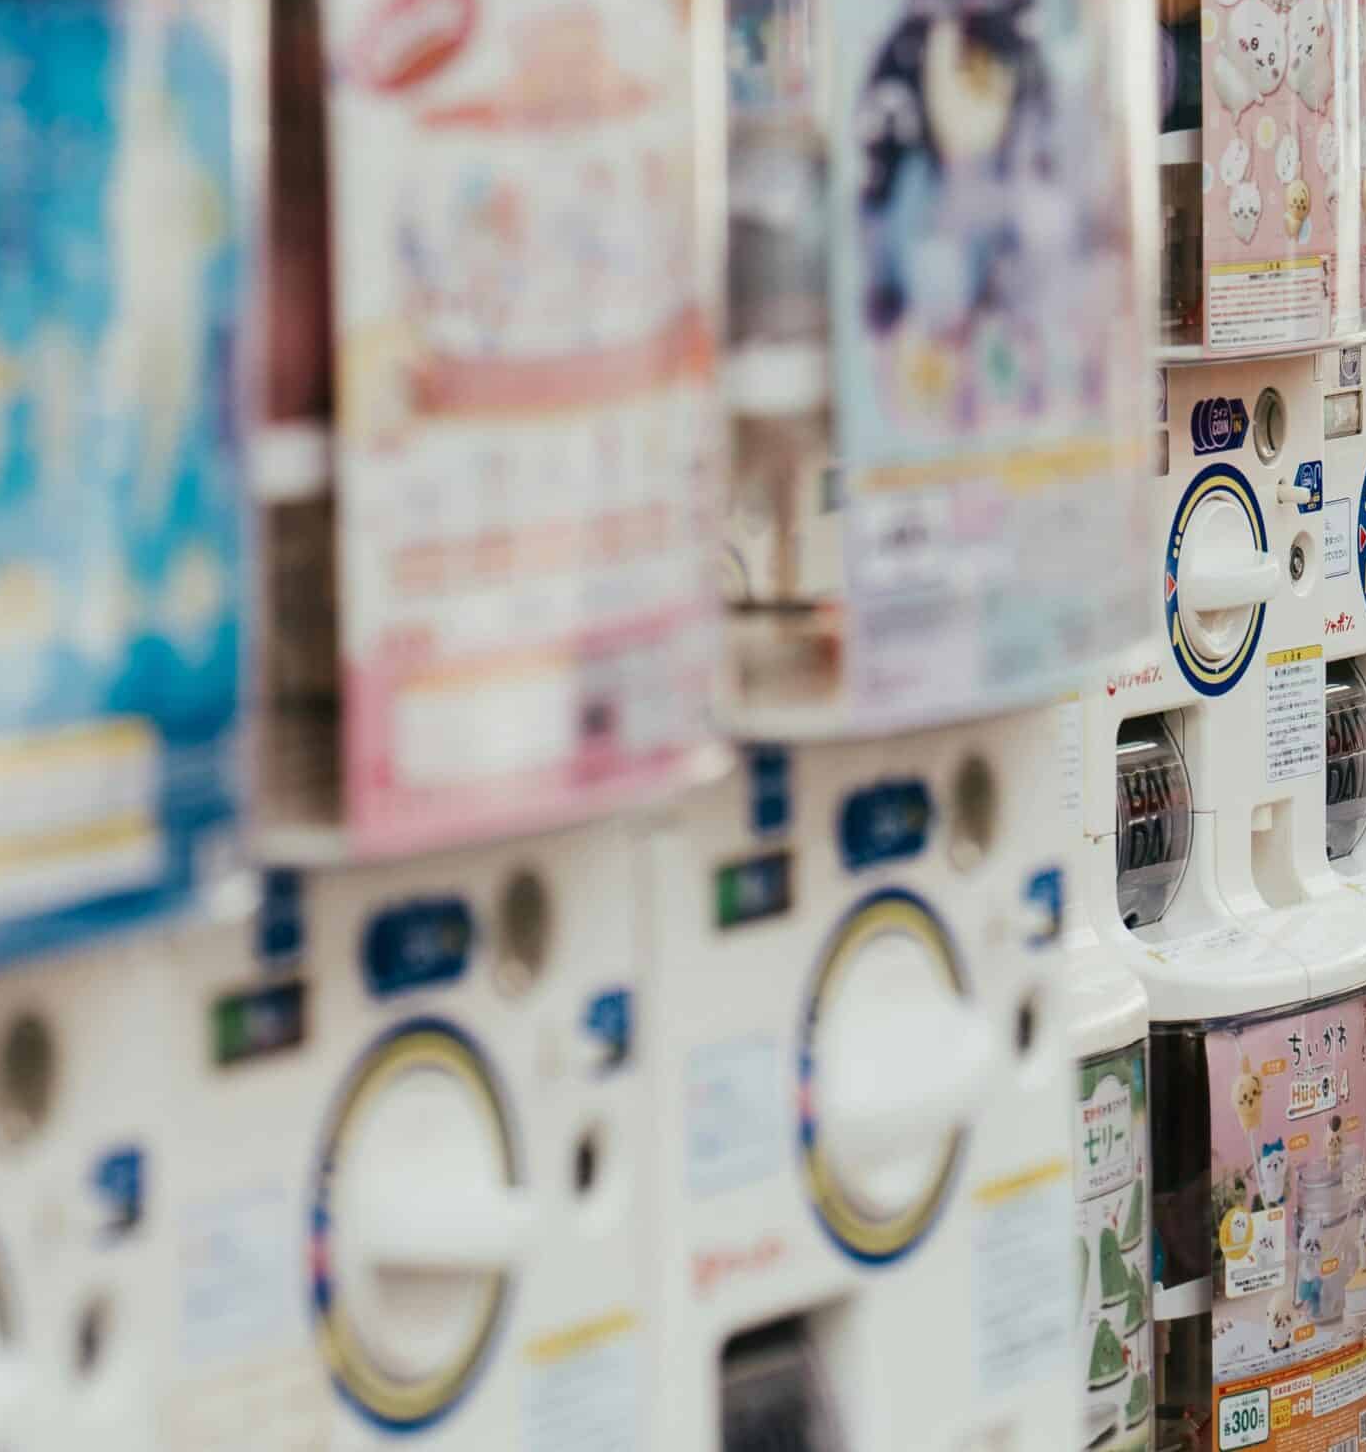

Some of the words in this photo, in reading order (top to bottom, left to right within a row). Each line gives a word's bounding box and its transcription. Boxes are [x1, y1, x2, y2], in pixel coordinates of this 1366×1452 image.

[1324, 612, 1355, 636] シャポン
[1287, 1018, 1347, 1066] ちいかわ
